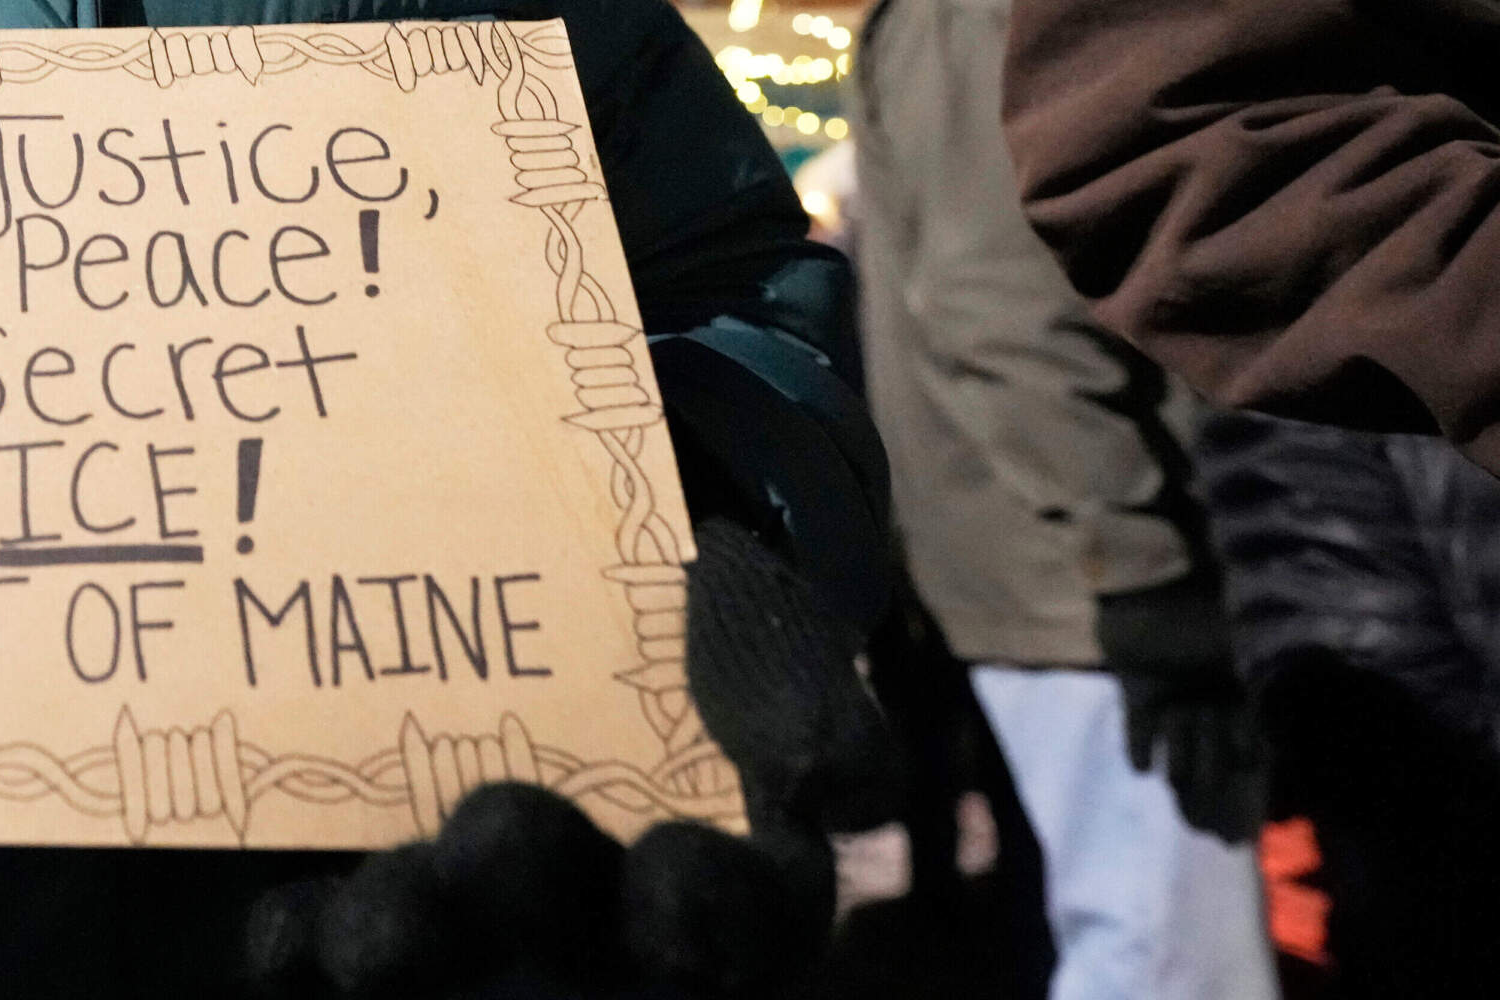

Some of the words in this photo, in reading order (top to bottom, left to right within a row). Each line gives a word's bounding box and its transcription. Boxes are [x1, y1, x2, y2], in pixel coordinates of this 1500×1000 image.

[14, 208, 381, 314] Peace!
[65, 579, 186, 685] OF
[232, 572, 554, 688] MAINE
